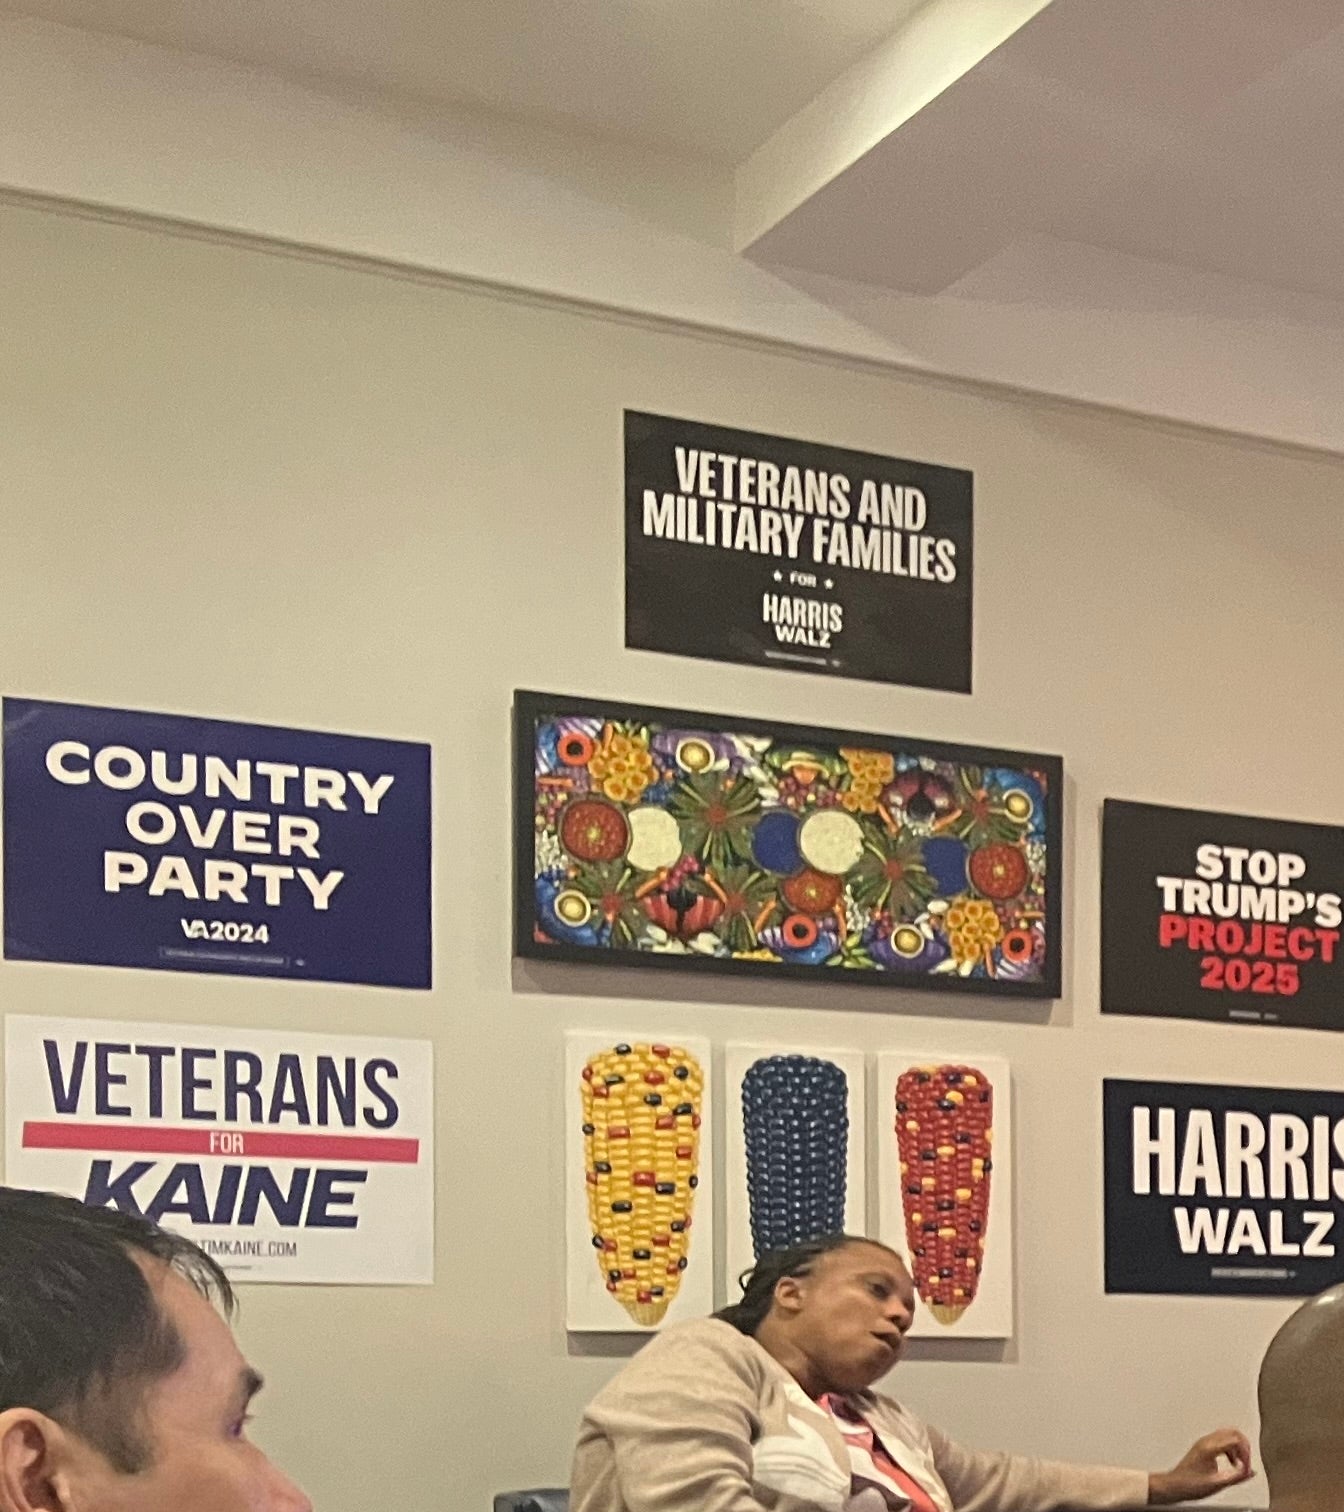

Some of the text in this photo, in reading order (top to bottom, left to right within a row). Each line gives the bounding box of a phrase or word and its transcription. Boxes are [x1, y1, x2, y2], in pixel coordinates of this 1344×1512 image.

[675, 446, 927, 532] VETERANS AND
[642, 490, 957, 583] MILITARY FAMILIES
[790, 571, 817, 588] FOR
[763, 592, 843, 633] HARRIS
[775, 624, 831, 649] WALZ
[45, 741, 395, 815] COUNTRY
[125, 801, 321, 859] OVER
[103, 850, 344, 911] PARTY
[1195, 844, 1306, 887] STOP
[1156, 876, 1343, 928] TRUMP'S
[1159, 915, 1340, 963] PROJECT
[1200, 956, 1300, 996] 2025
[42, 1039, 400, 1130] VETERANS
[209, 1131, 245, 1156] FOR
[84, 1160, 368, 1229] KAINE
[195, 1240, 297, 1257] TIMKAINE.COM
[1174, 1207, 1335, 1257] WALZ
